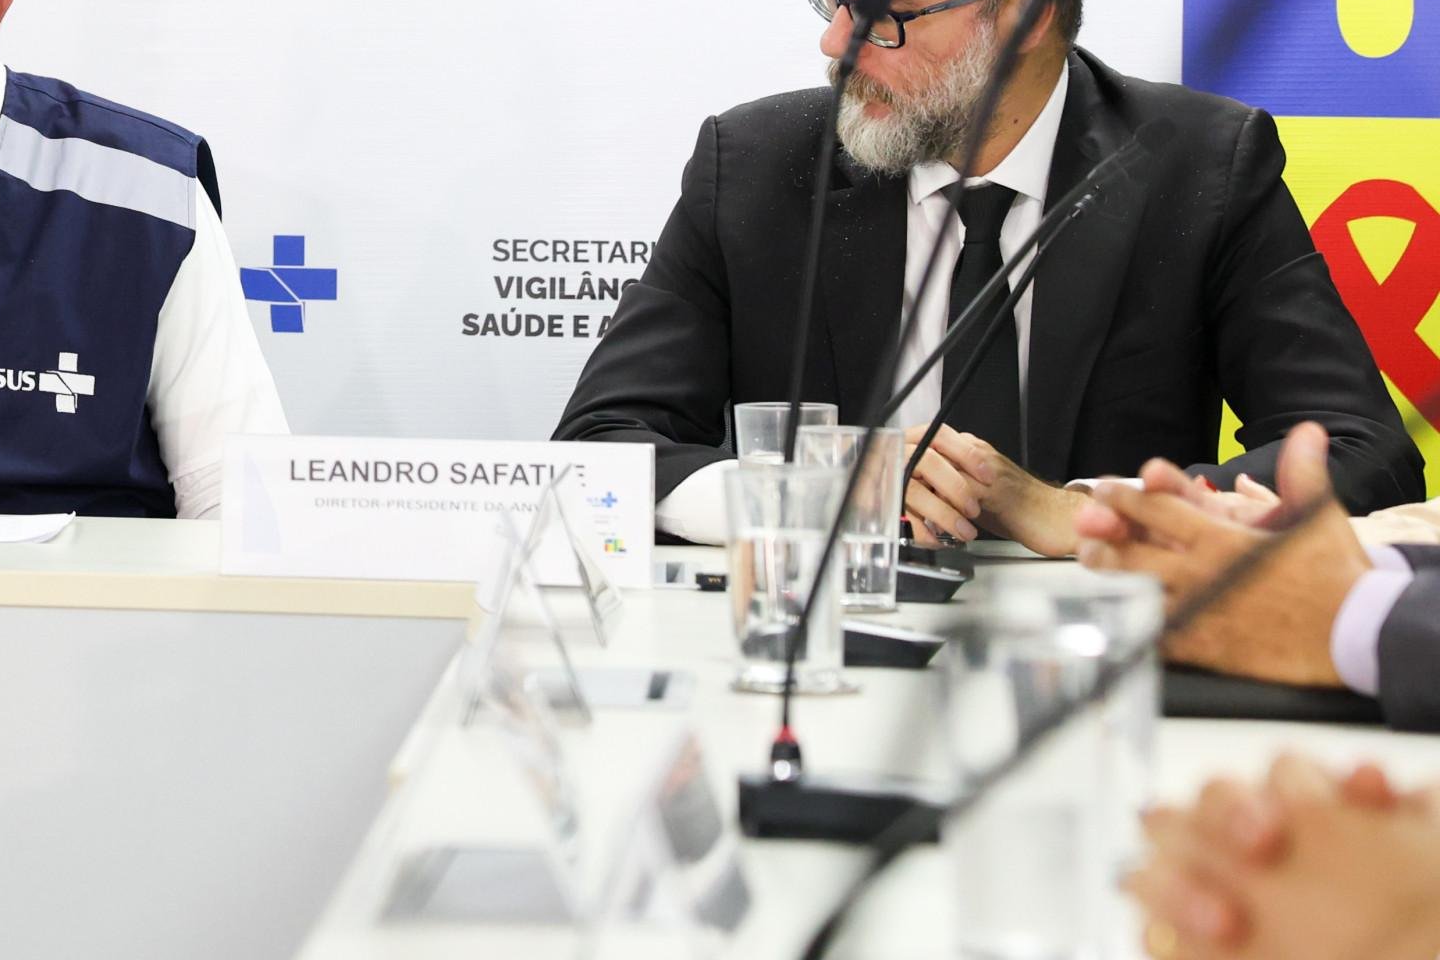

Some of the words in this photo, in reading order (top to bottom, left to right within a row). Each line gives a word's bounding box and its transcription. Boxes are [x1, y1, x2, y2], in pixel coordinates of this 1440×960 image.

[461, 306, 565, 338] SAÚDE
[572, 314, 590, 339] E
[290, 459, 439, 485] LEANDRO
[313, 497, 479, 513] DIRETOR-PRESIDENTE
